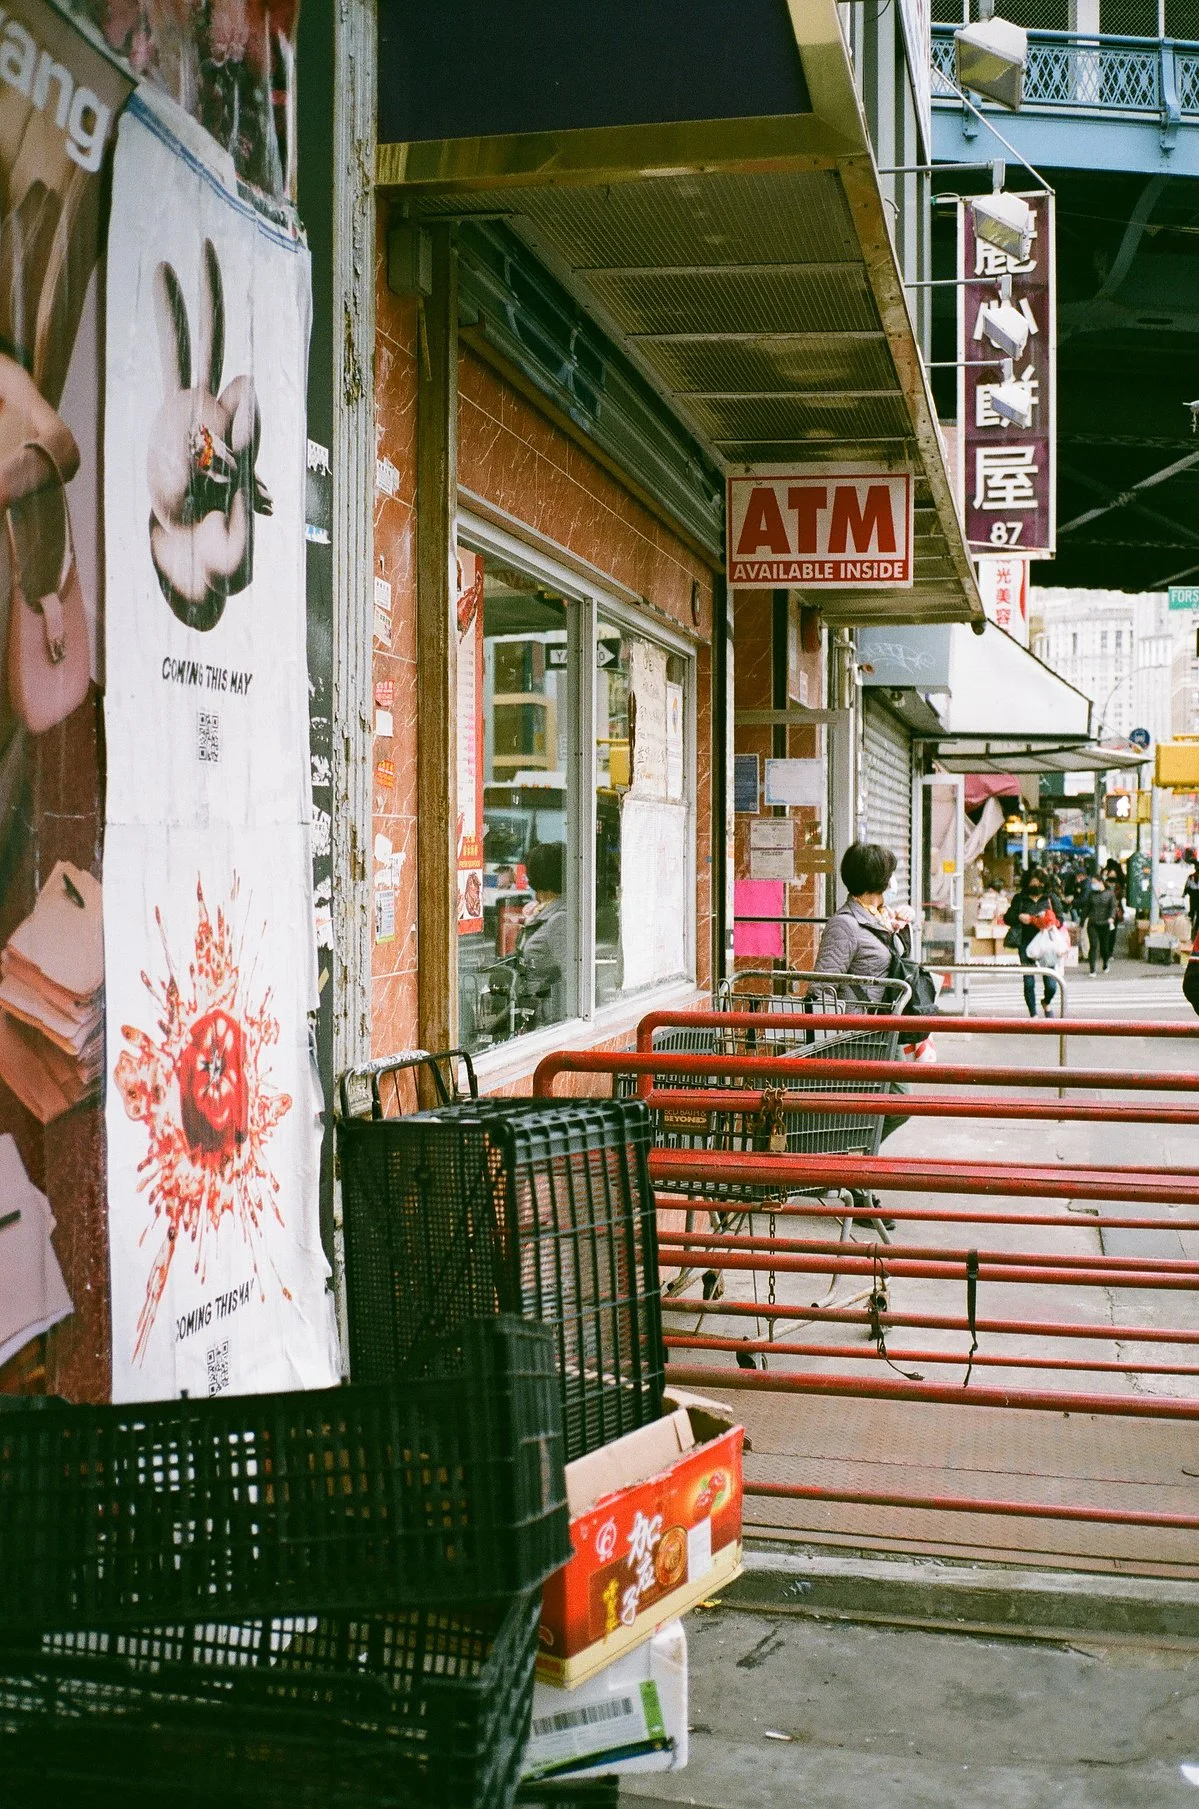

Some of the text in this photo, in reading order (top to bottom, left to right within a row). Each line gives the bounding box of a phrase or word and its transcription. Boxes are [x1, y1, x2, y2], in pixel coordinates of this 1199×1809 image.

[0, 9, 111, 173] ang
[736, 485, 897, 555] ATM
[989, 521, 1023, 546] 87
[733, 562, 904, 580] AVAILABLE INSIDE
[162, 656, 254, 696] COMING THIS MAY
[664, 1115, 708, 1124] BEYOND
[214, 1289, 239, 1320] THIS
